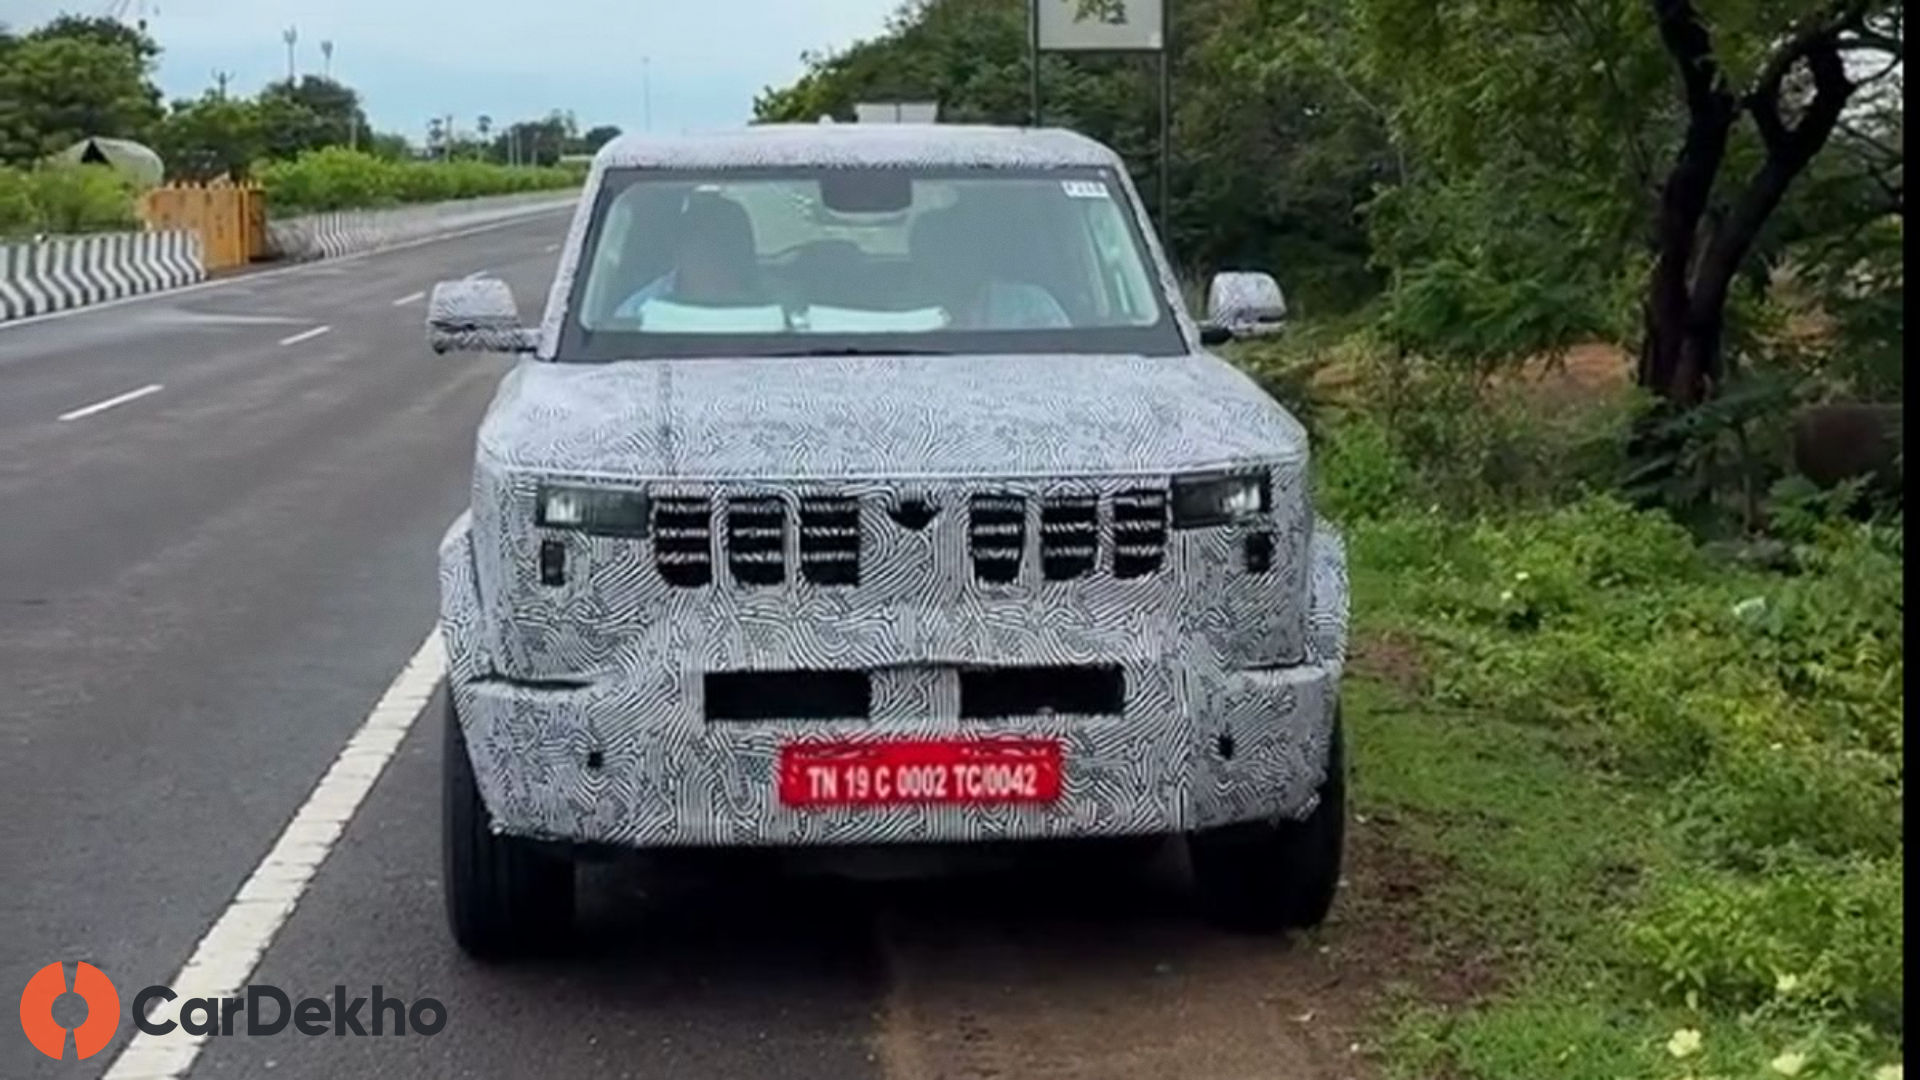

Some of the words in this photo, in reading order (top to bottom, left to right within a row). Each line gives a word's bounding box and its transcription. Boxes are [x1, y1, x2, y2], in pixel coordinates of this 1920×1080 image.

[807, 766, 837, 798] TN
[845, 765, 869, 798] 19
[875, 765, 891, 798] C
[897, 765, 947, 797] 0002
